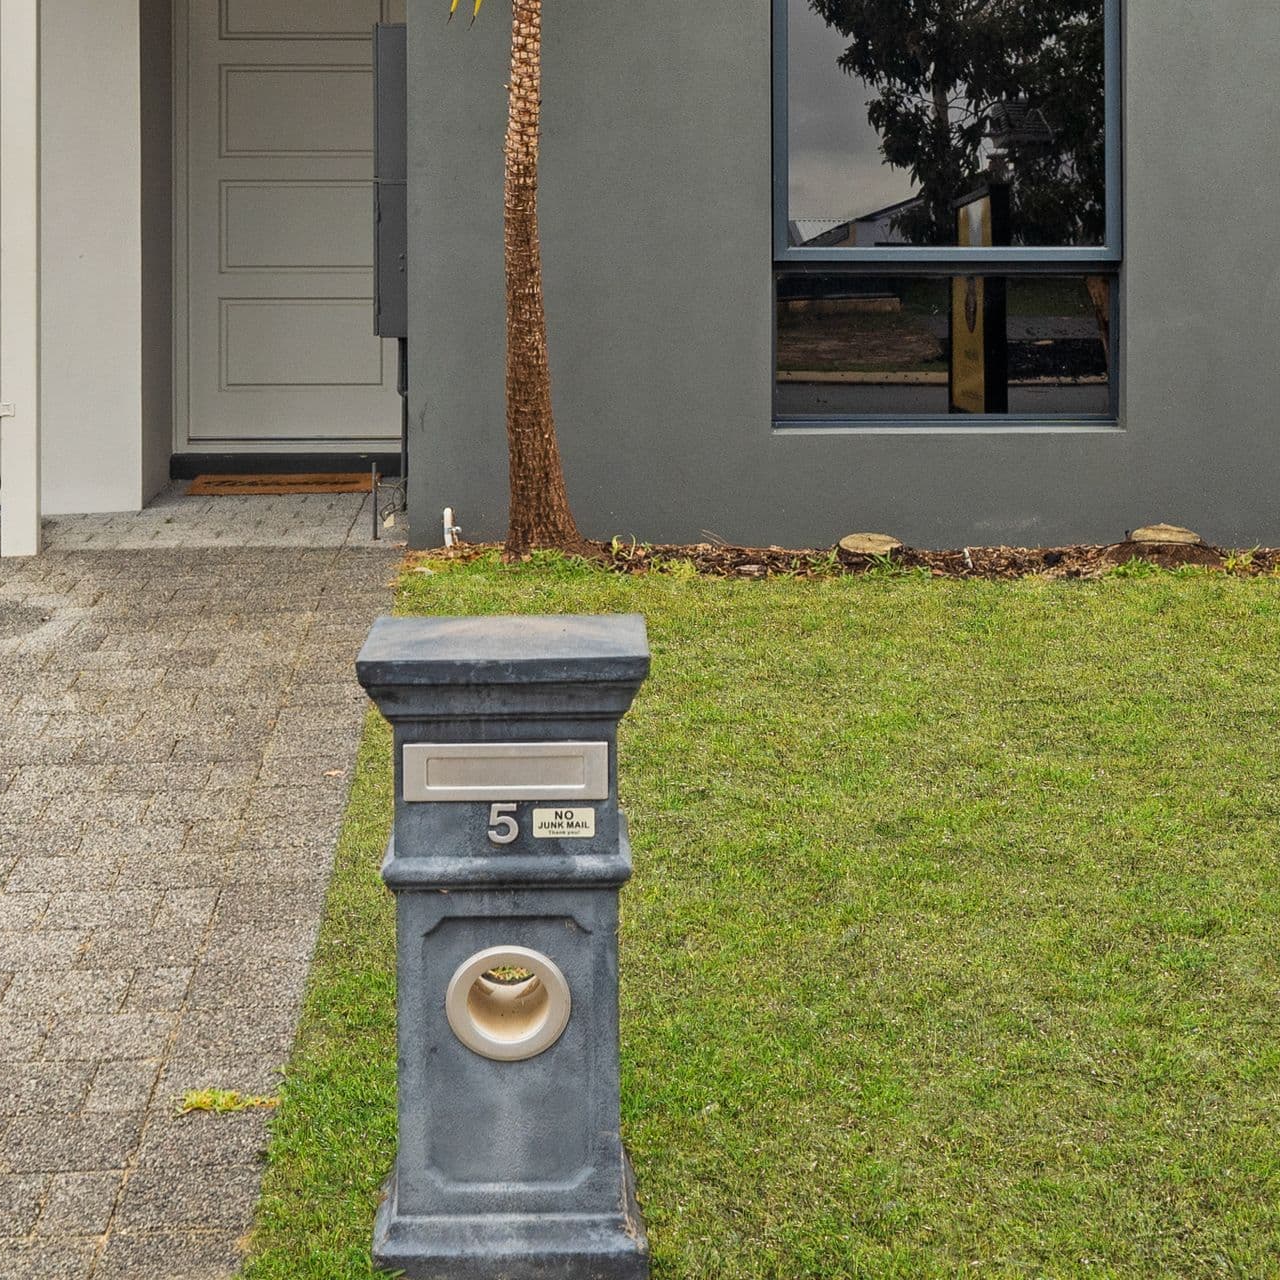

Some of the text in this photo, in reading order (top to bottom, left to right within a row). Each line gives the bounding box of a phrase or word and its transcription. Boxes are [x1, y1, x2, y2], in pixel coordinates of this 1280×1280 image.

[554, 810, 574, 820] NO
[487, 803, 520, 844] 5
[538, 821, 590, 829] JUNK MAIL
